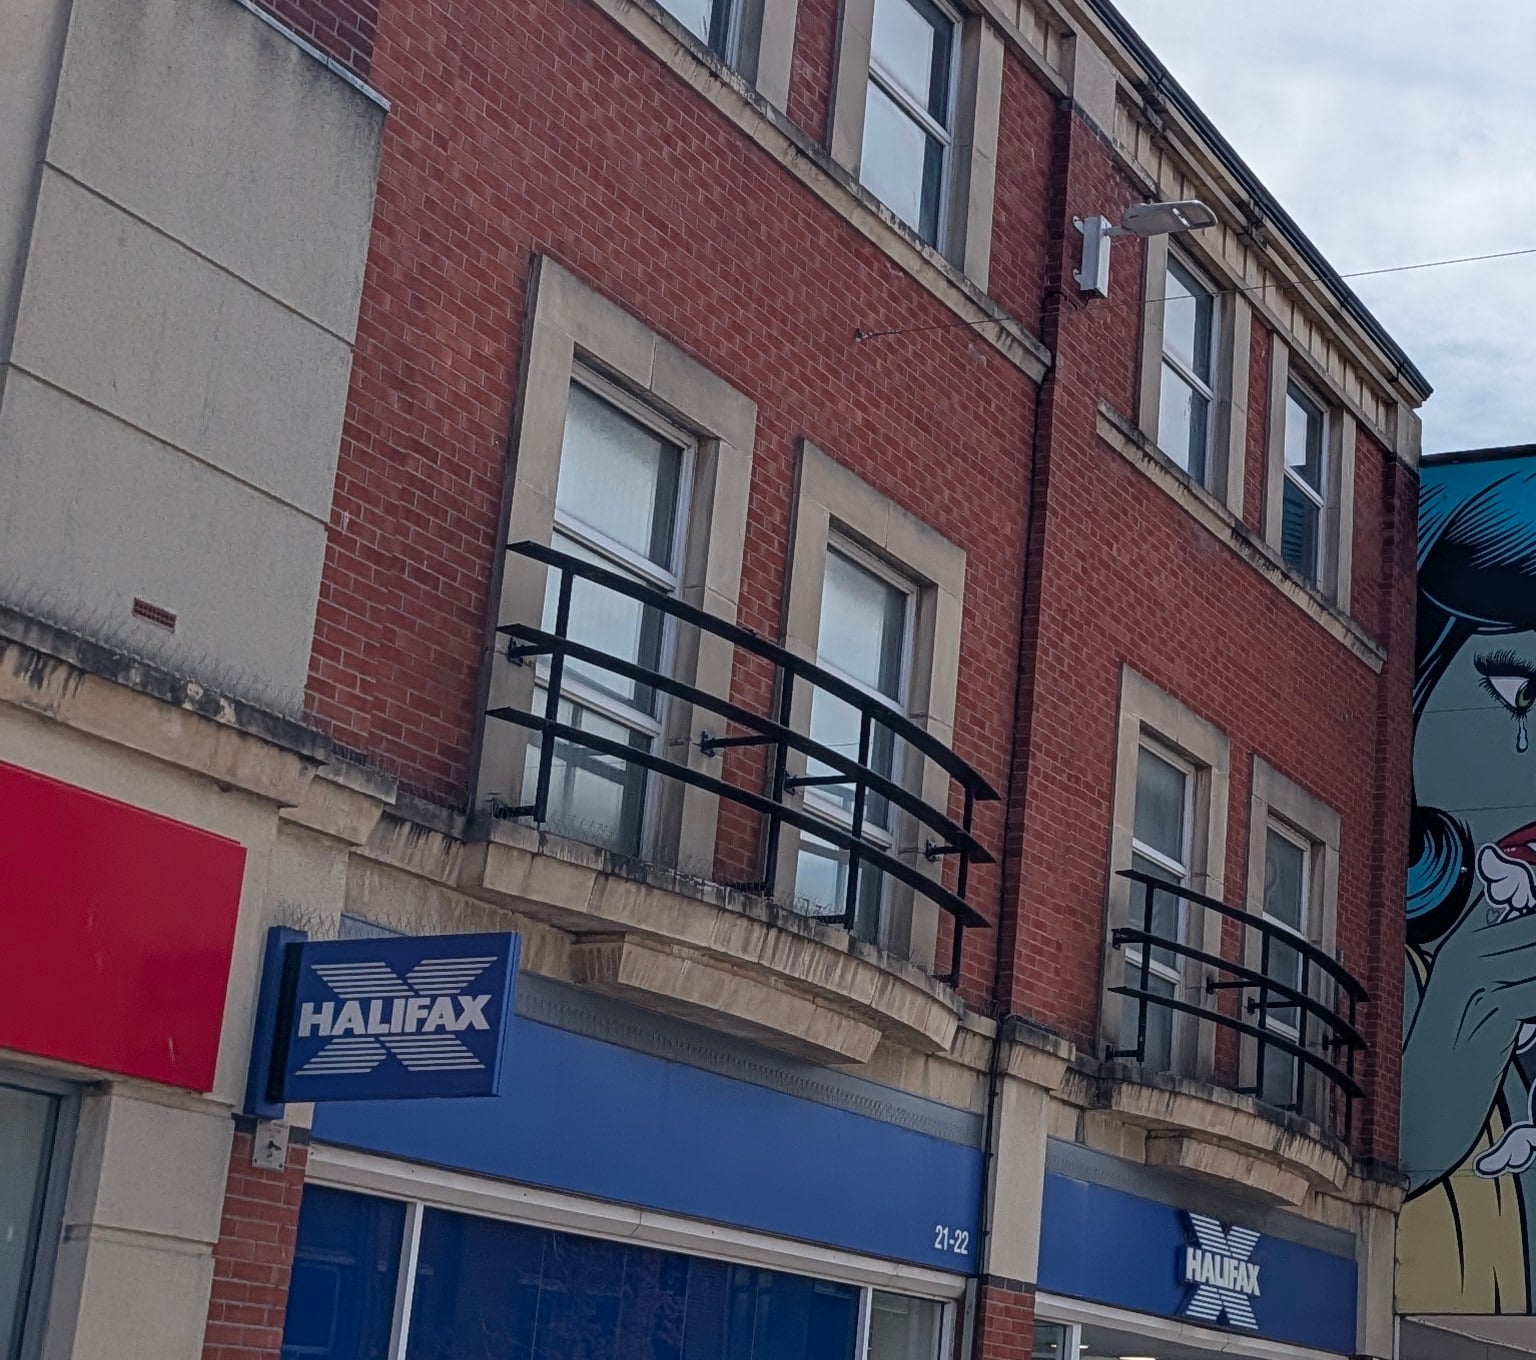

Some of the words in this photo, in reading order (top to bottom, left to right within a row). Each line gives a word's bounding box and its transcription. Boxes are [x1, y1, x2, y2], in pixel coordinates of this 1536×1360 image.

[298, 995, 492, 1037] HALIFAX
[934, 1225, 969, 1255] 21-22
[1186, 1246, 1260, 1296] HALIFAX
